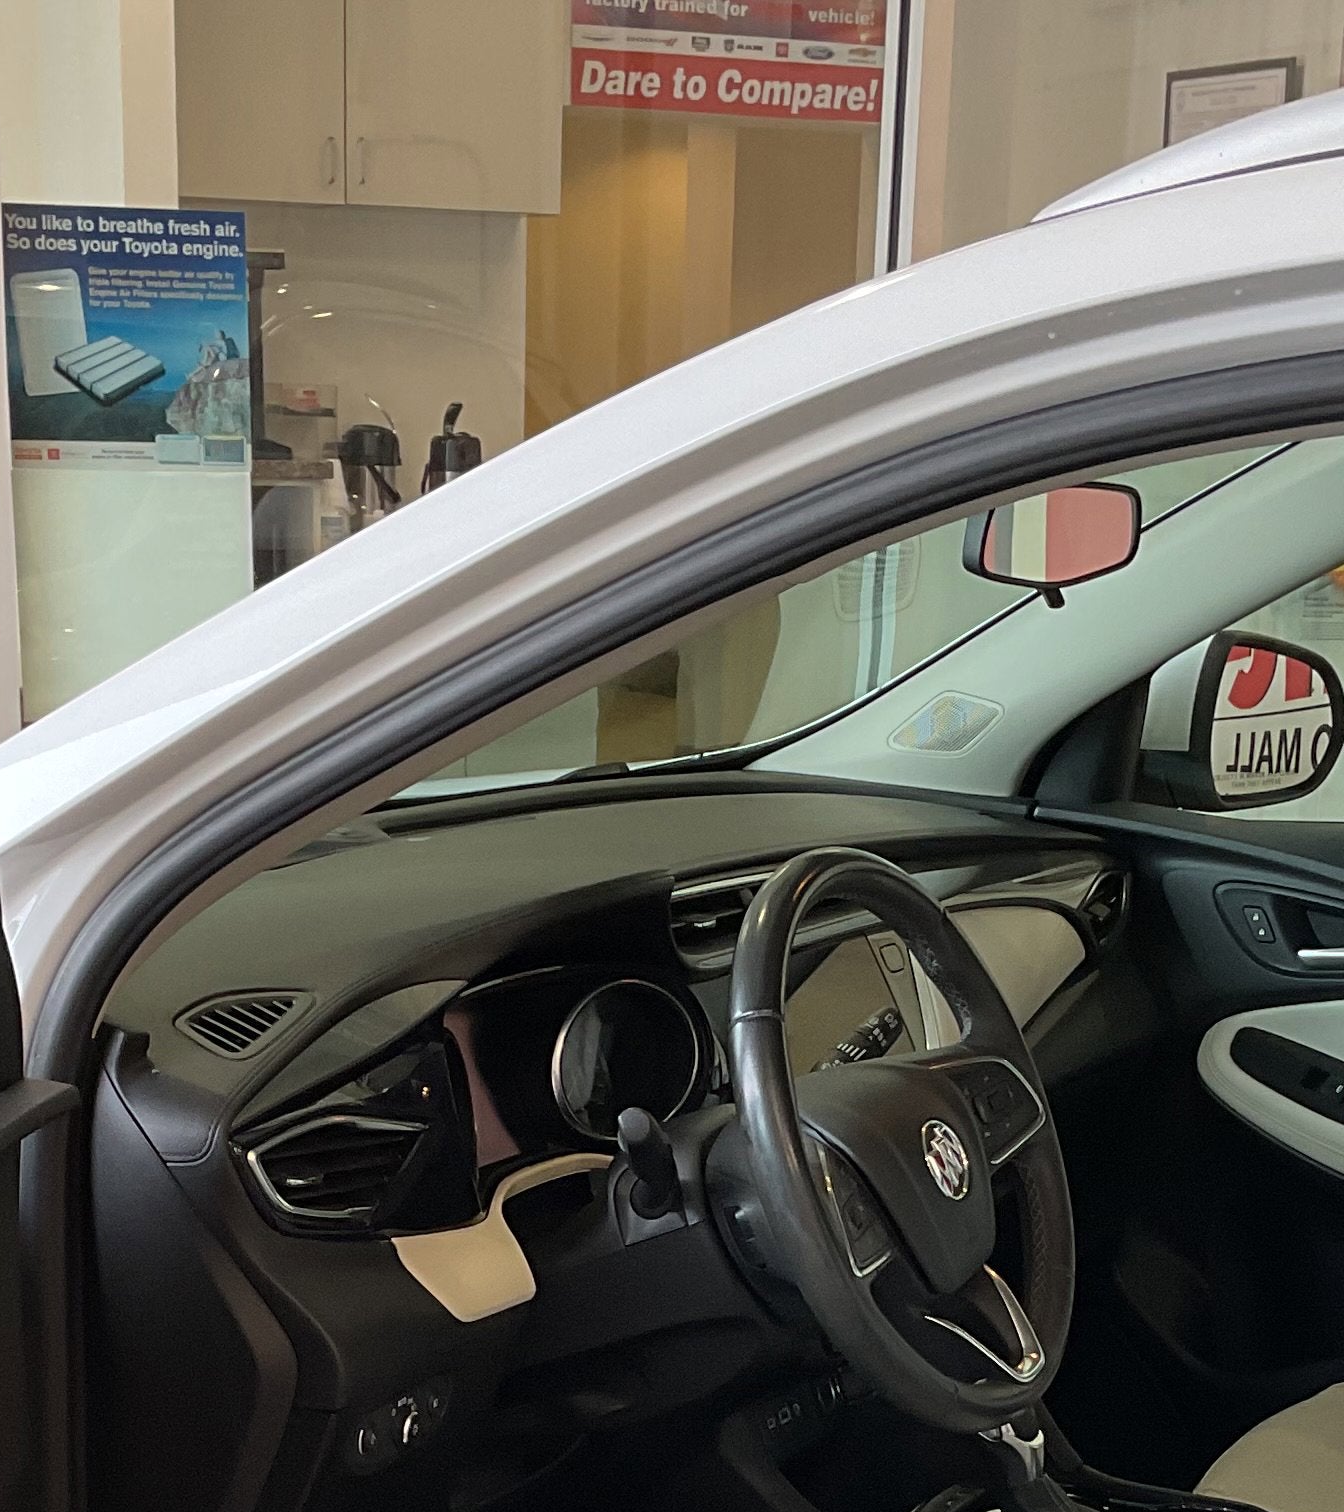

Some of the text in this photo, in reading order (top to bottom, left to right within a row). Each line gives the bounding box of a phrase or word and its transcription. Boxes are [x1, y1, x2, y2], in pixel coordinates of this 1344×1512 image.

[654, 0, 718, 15] trained
[724, 0, 749, 17] for
[808, 8, 876, 26] vehicle!
[580, 60, 879, 114] Dare to Compare!
[4, 213, 240, 238] You like to breathe fresh air.
[6, 233, 244, 260] So does your Toyota engine.
